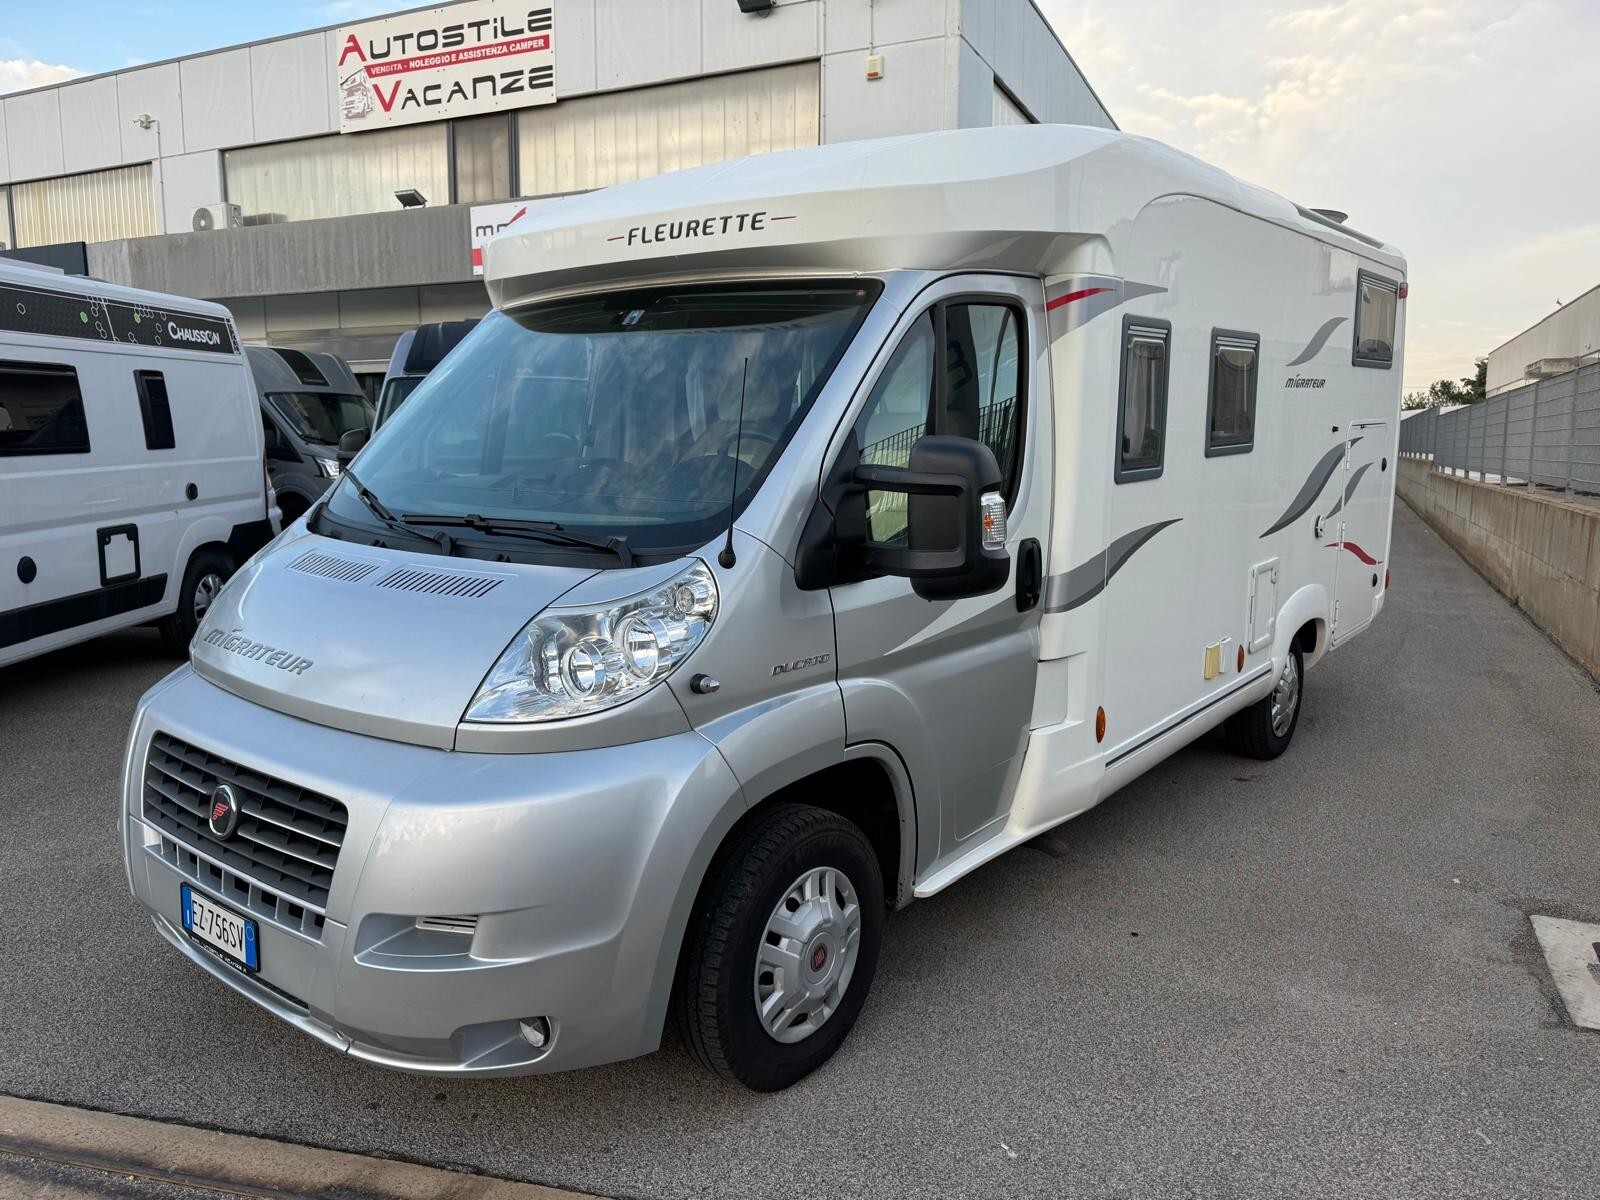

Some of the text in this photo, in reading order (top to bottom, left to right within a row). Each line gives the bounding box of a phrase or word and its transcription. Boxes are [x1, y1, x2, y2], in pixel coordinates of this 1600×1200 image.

[371, 63, 403, 75] VENDITA
[409, 55, 450, 69] NOLEGGIO
[451, 53, 457, 62] E
[458, 45, 508, 61] ASSISTENZA
[509, 38, 545, 52] CAMPER
[627, 211, 768, 246] FLEURETTE
[168, 321, 221, 345] CHAUSSON
[771, 653, 831, 676] DUCATO
